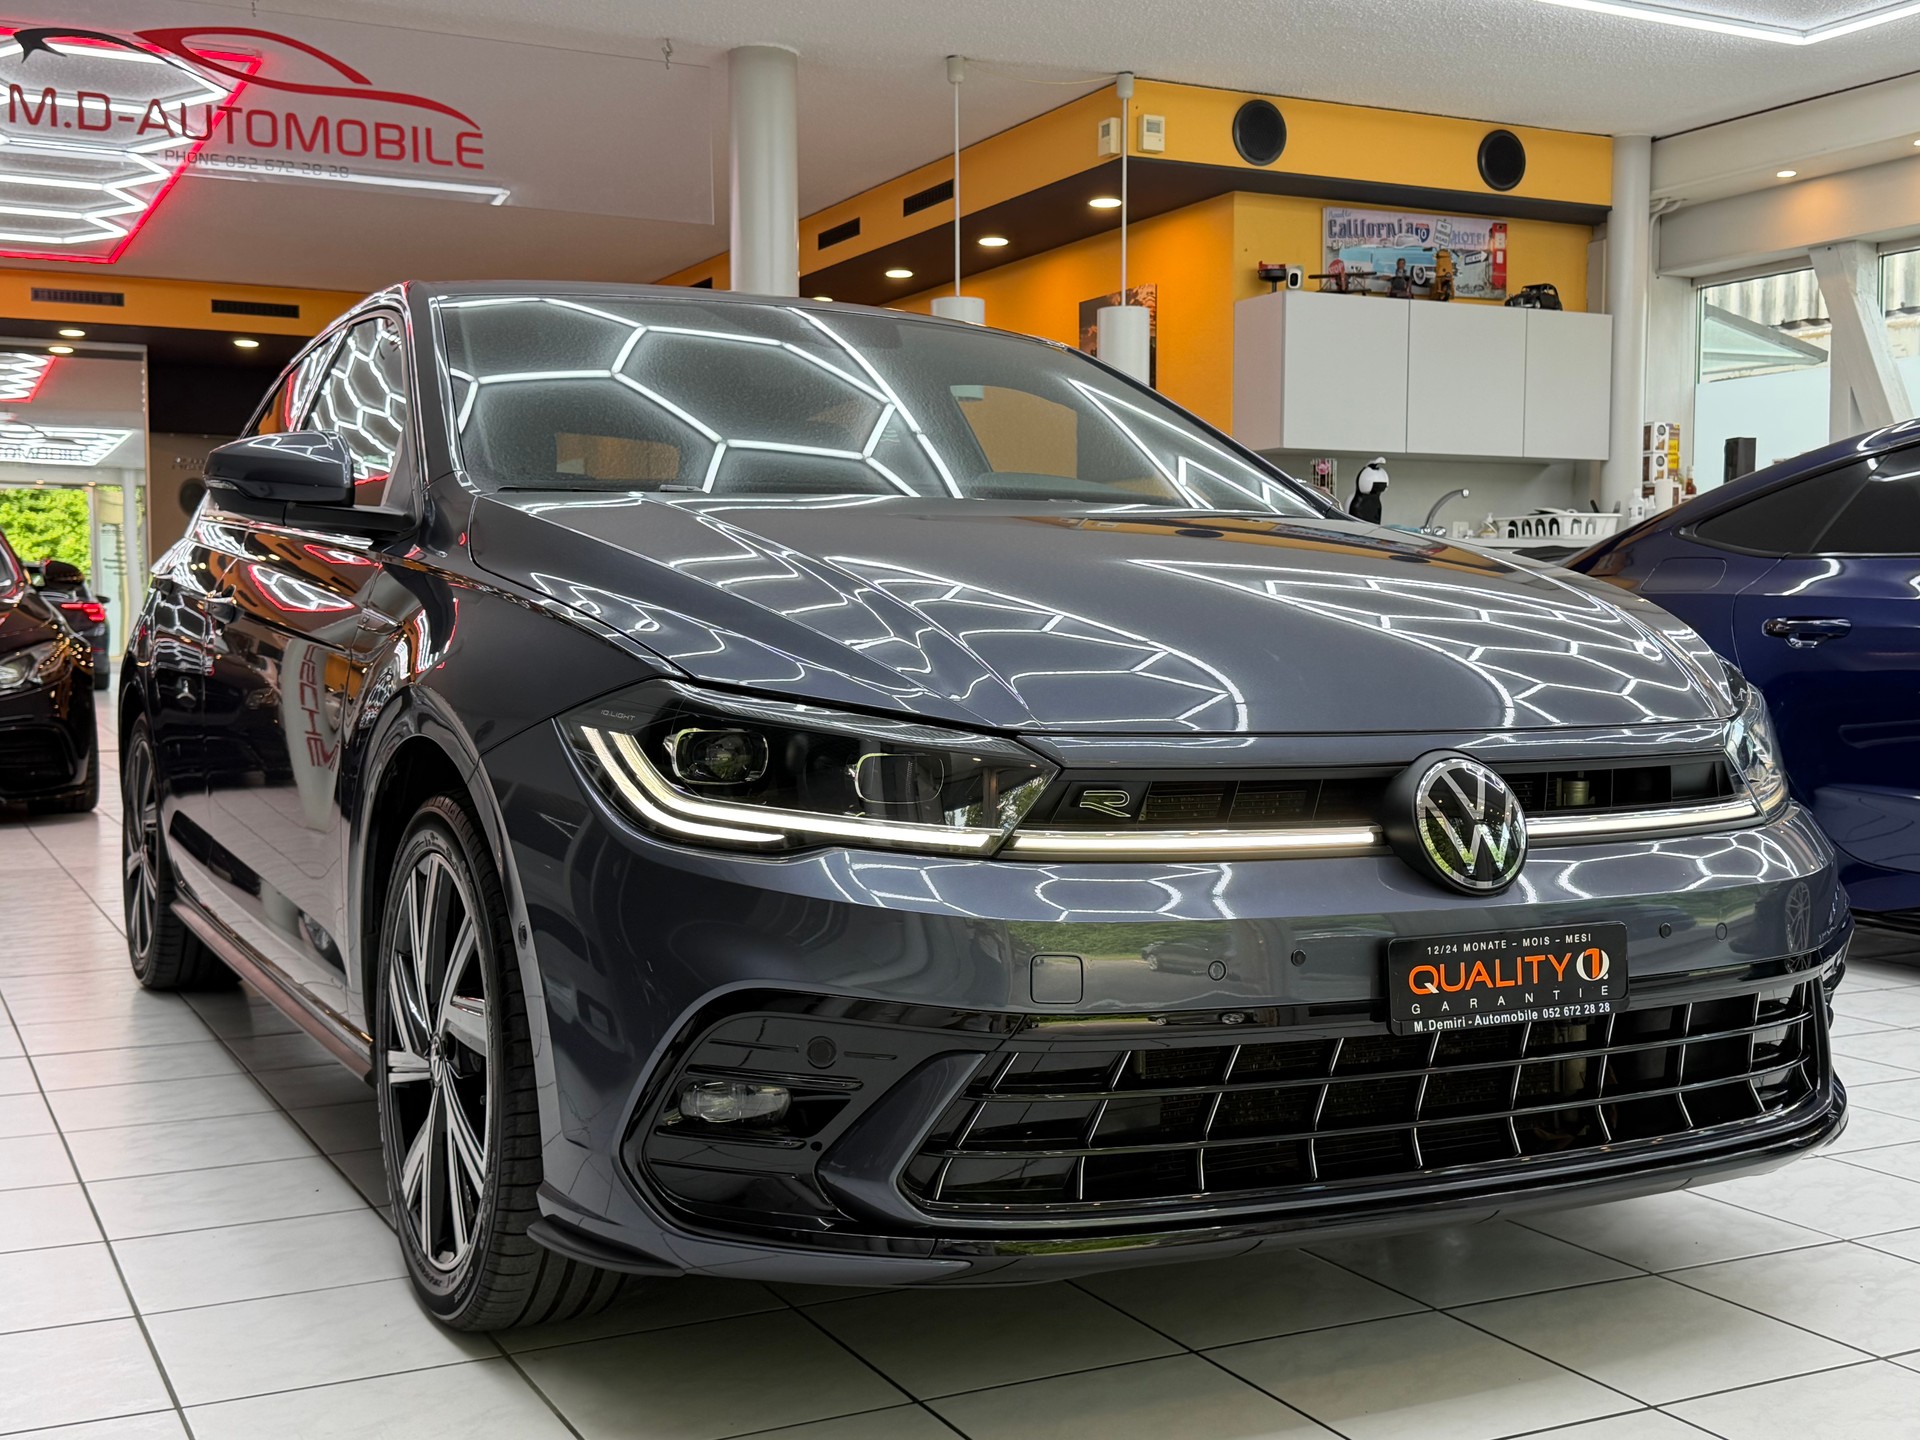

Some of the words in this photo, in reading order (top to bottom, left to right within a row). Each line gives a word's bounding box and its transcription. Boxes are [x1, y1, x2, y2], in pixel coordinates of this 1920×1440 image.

[8, 83, 486, 170] M.D-AUTOMOBILE
[165, 149, 220, 167] PHONE
[264, 158, 295, 174] 672
[302, 162, 322, 176] 28
[329, 165, 350, 179] 28
[1328, 218, 1415, 239] California
[1427, 945, 1458, 955] 12/24
[1463, 940, 1507, 952] MONATE
[1522, 936, 1550, 947] MOIS
[1565, 933, 1592, 944] MESI
[1408, 952, 1572, 995] QUALITY
[1411, 985, 1609, 1015] GARANTIE
[1542, 1007, 1561, 1019] 052
[1563, 1005, 1581, 1017] 672
[1584, 1004, 1596, 1015] 28
[1598, 1002, 1611, 1013] 28
